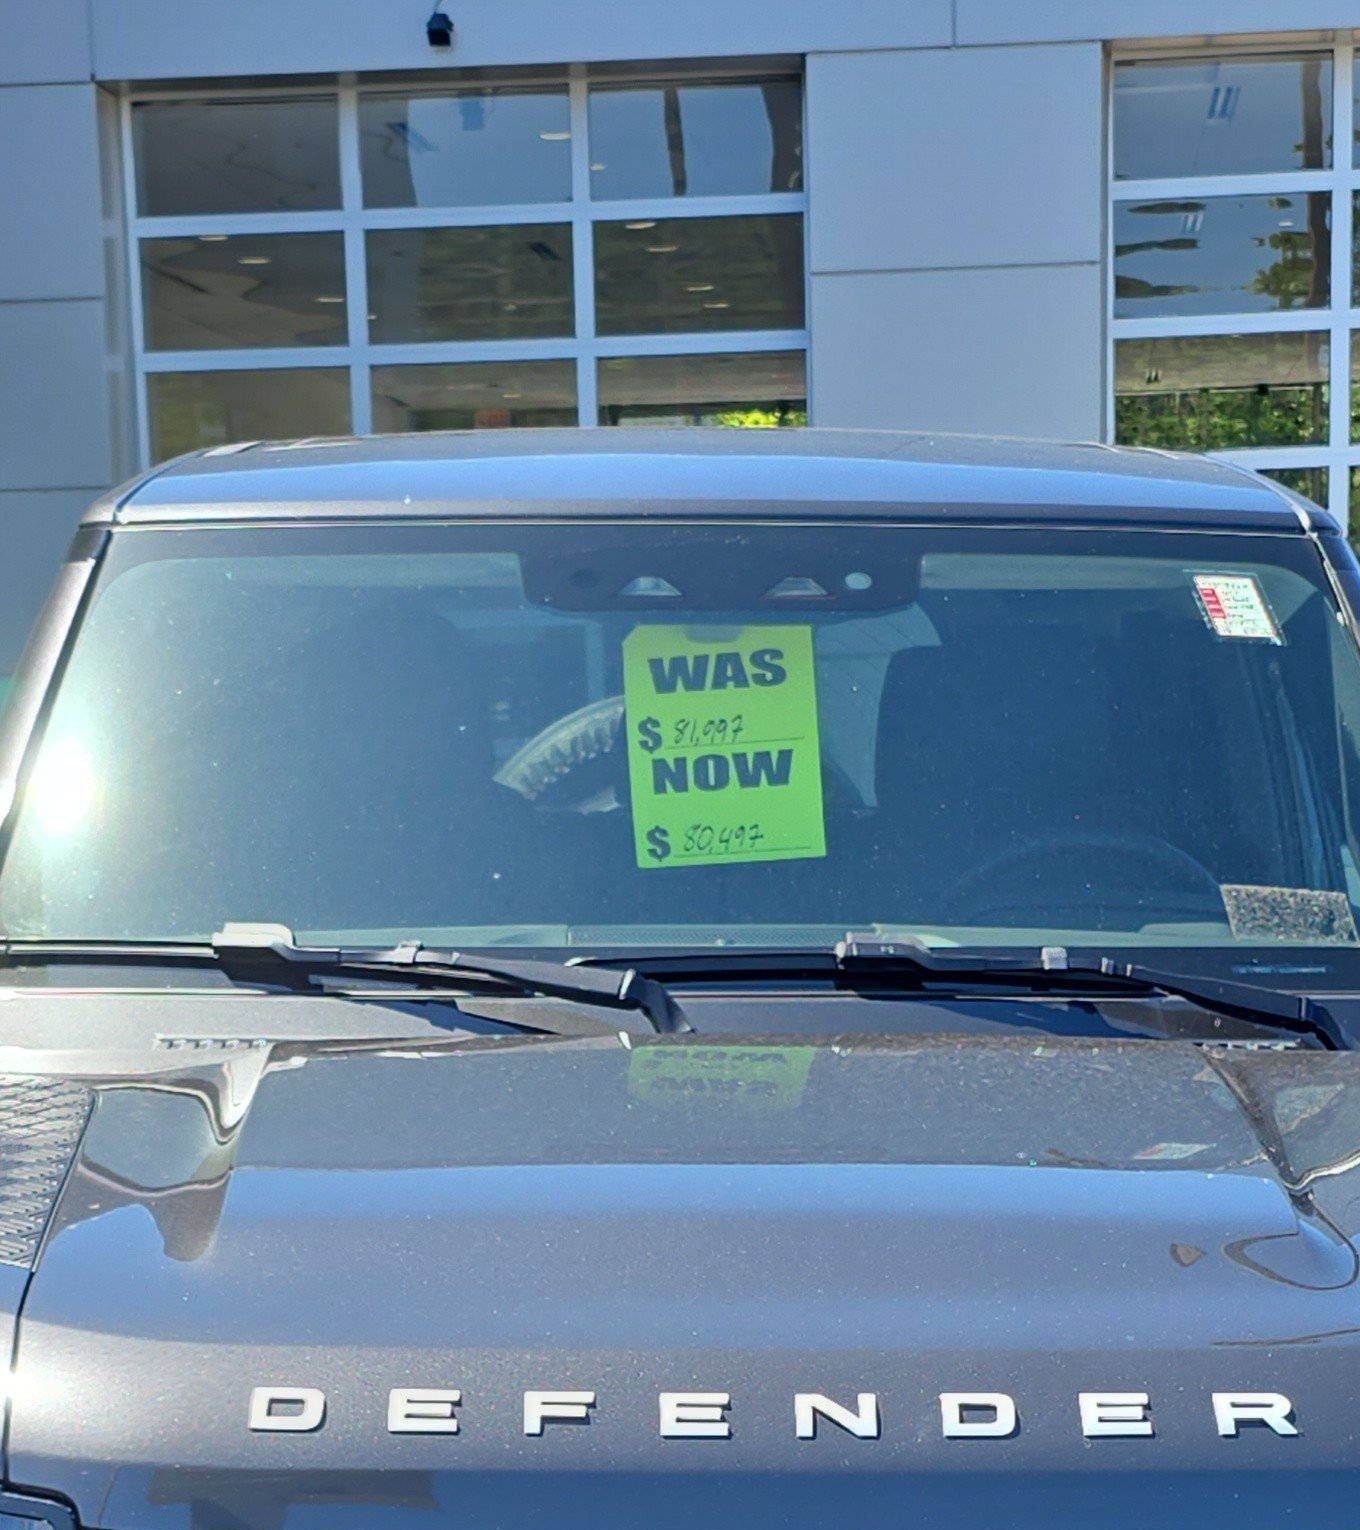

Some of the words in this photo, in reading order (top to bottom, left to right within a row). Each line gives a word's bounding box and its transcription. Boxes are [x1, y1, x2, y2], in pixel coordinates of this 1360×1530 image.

[647, 648, 787, 695] WAS
[651, 749, 794, 795] NOW
[247, 1386, 1300, 1436] DEFENDER
